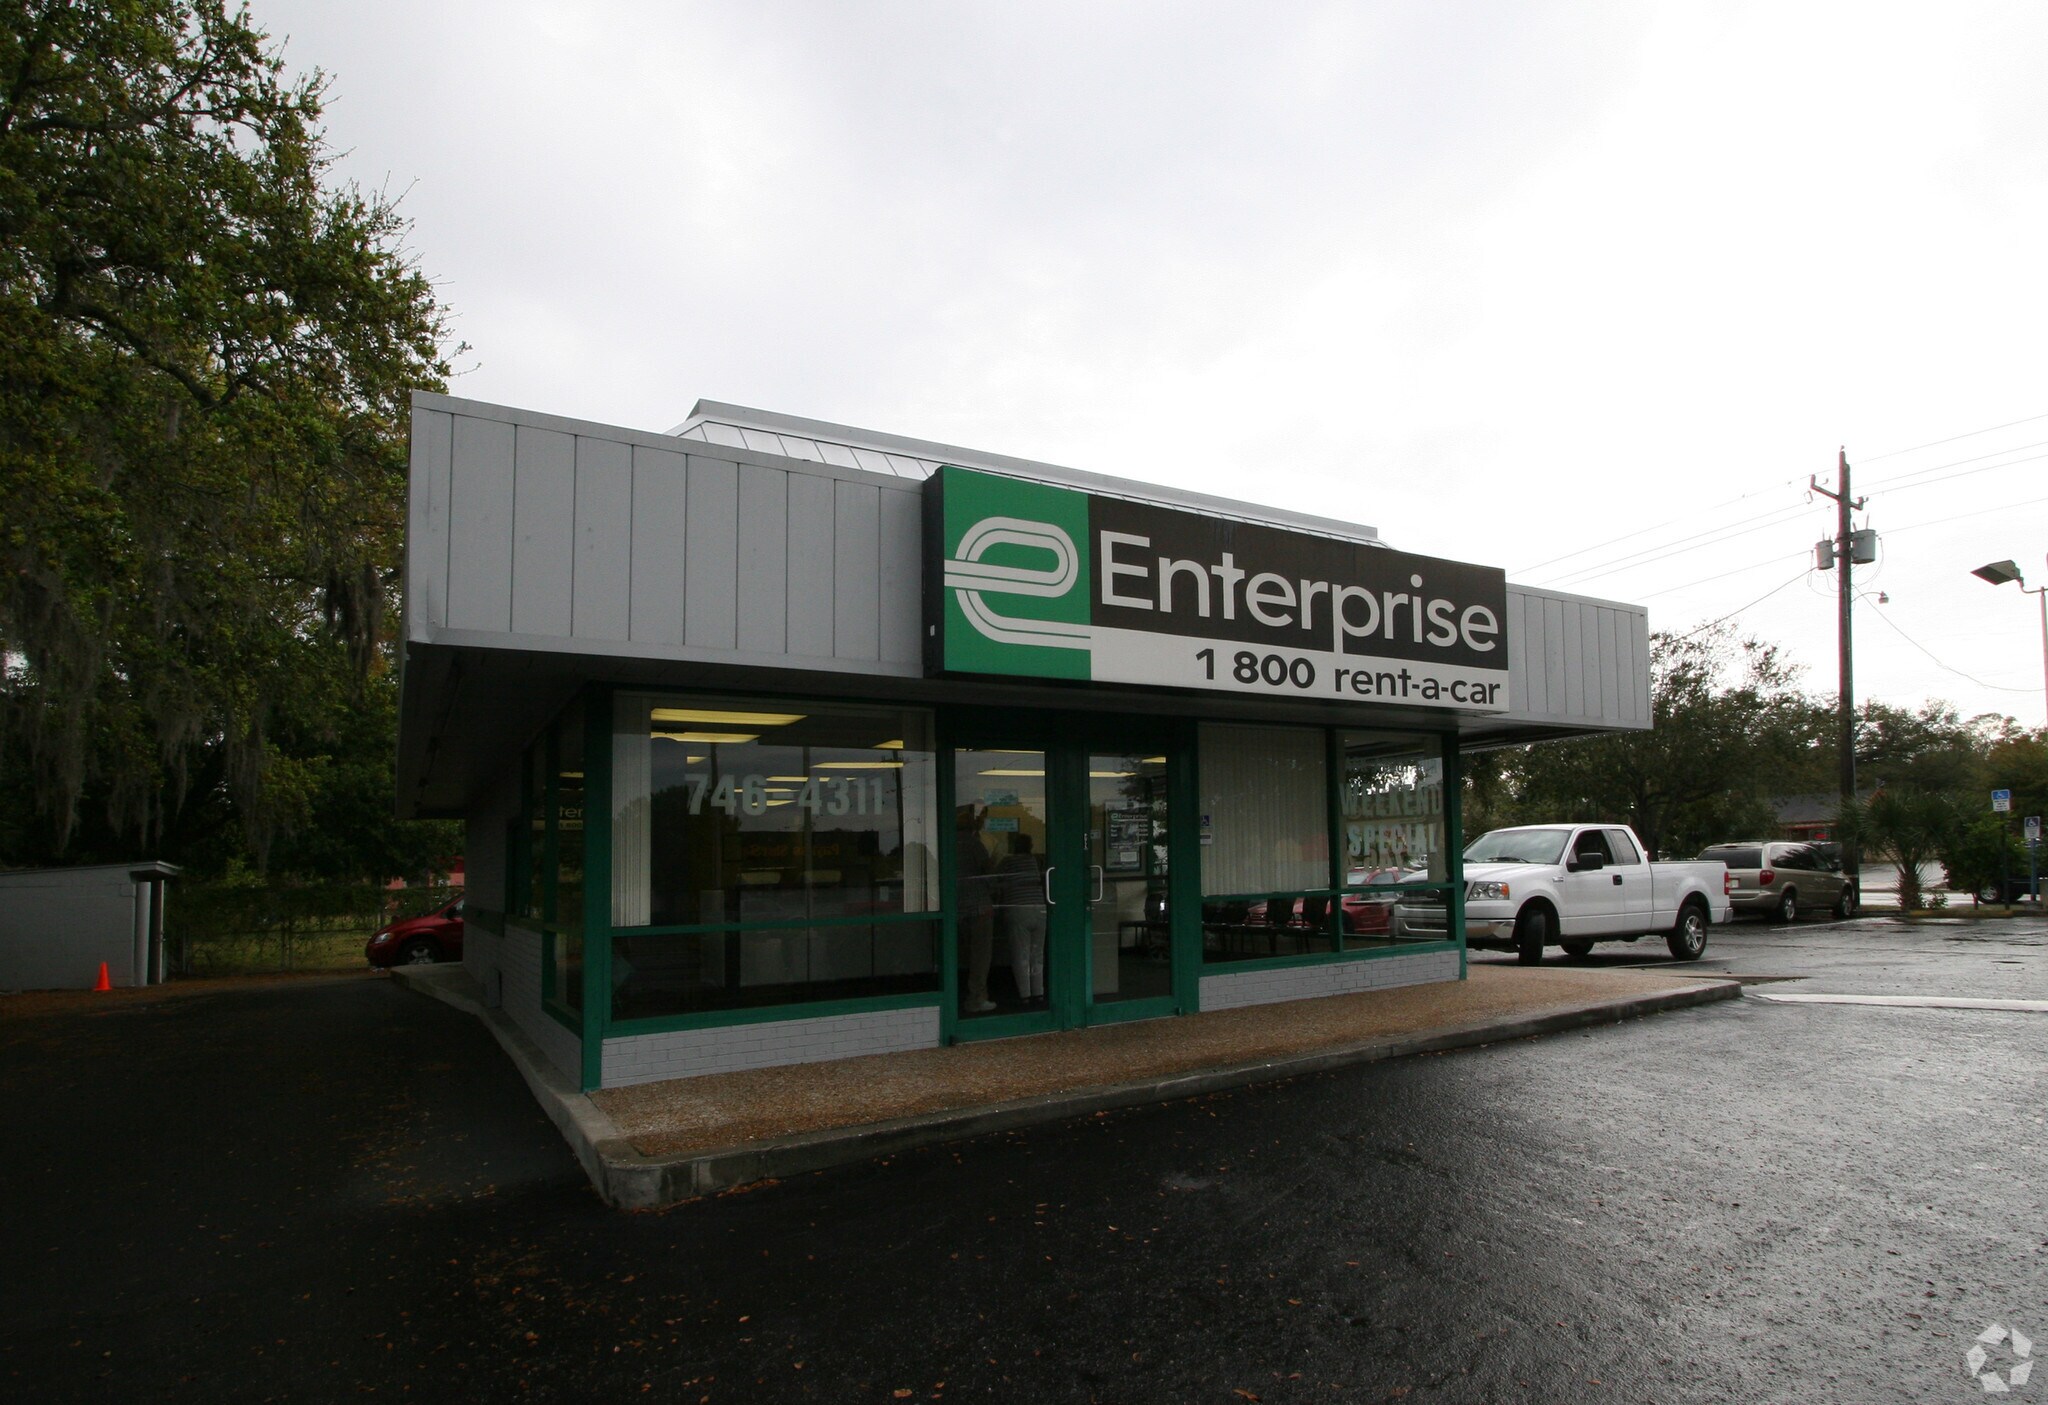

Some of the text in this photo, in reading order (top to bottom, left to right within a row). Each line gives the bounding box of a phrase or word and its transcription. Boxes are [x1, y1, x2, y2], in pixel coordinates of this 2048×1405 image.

[1100, 529, 1499, 654] Enterprise
[1195, 648, 1501, 705] 1 800 rent-a-car
[684, 773, 882, 816] 746-4311
[1339, 783, 1442, 817] WEEKEND
[1347, 824, 1438, 856] SPECIAL
